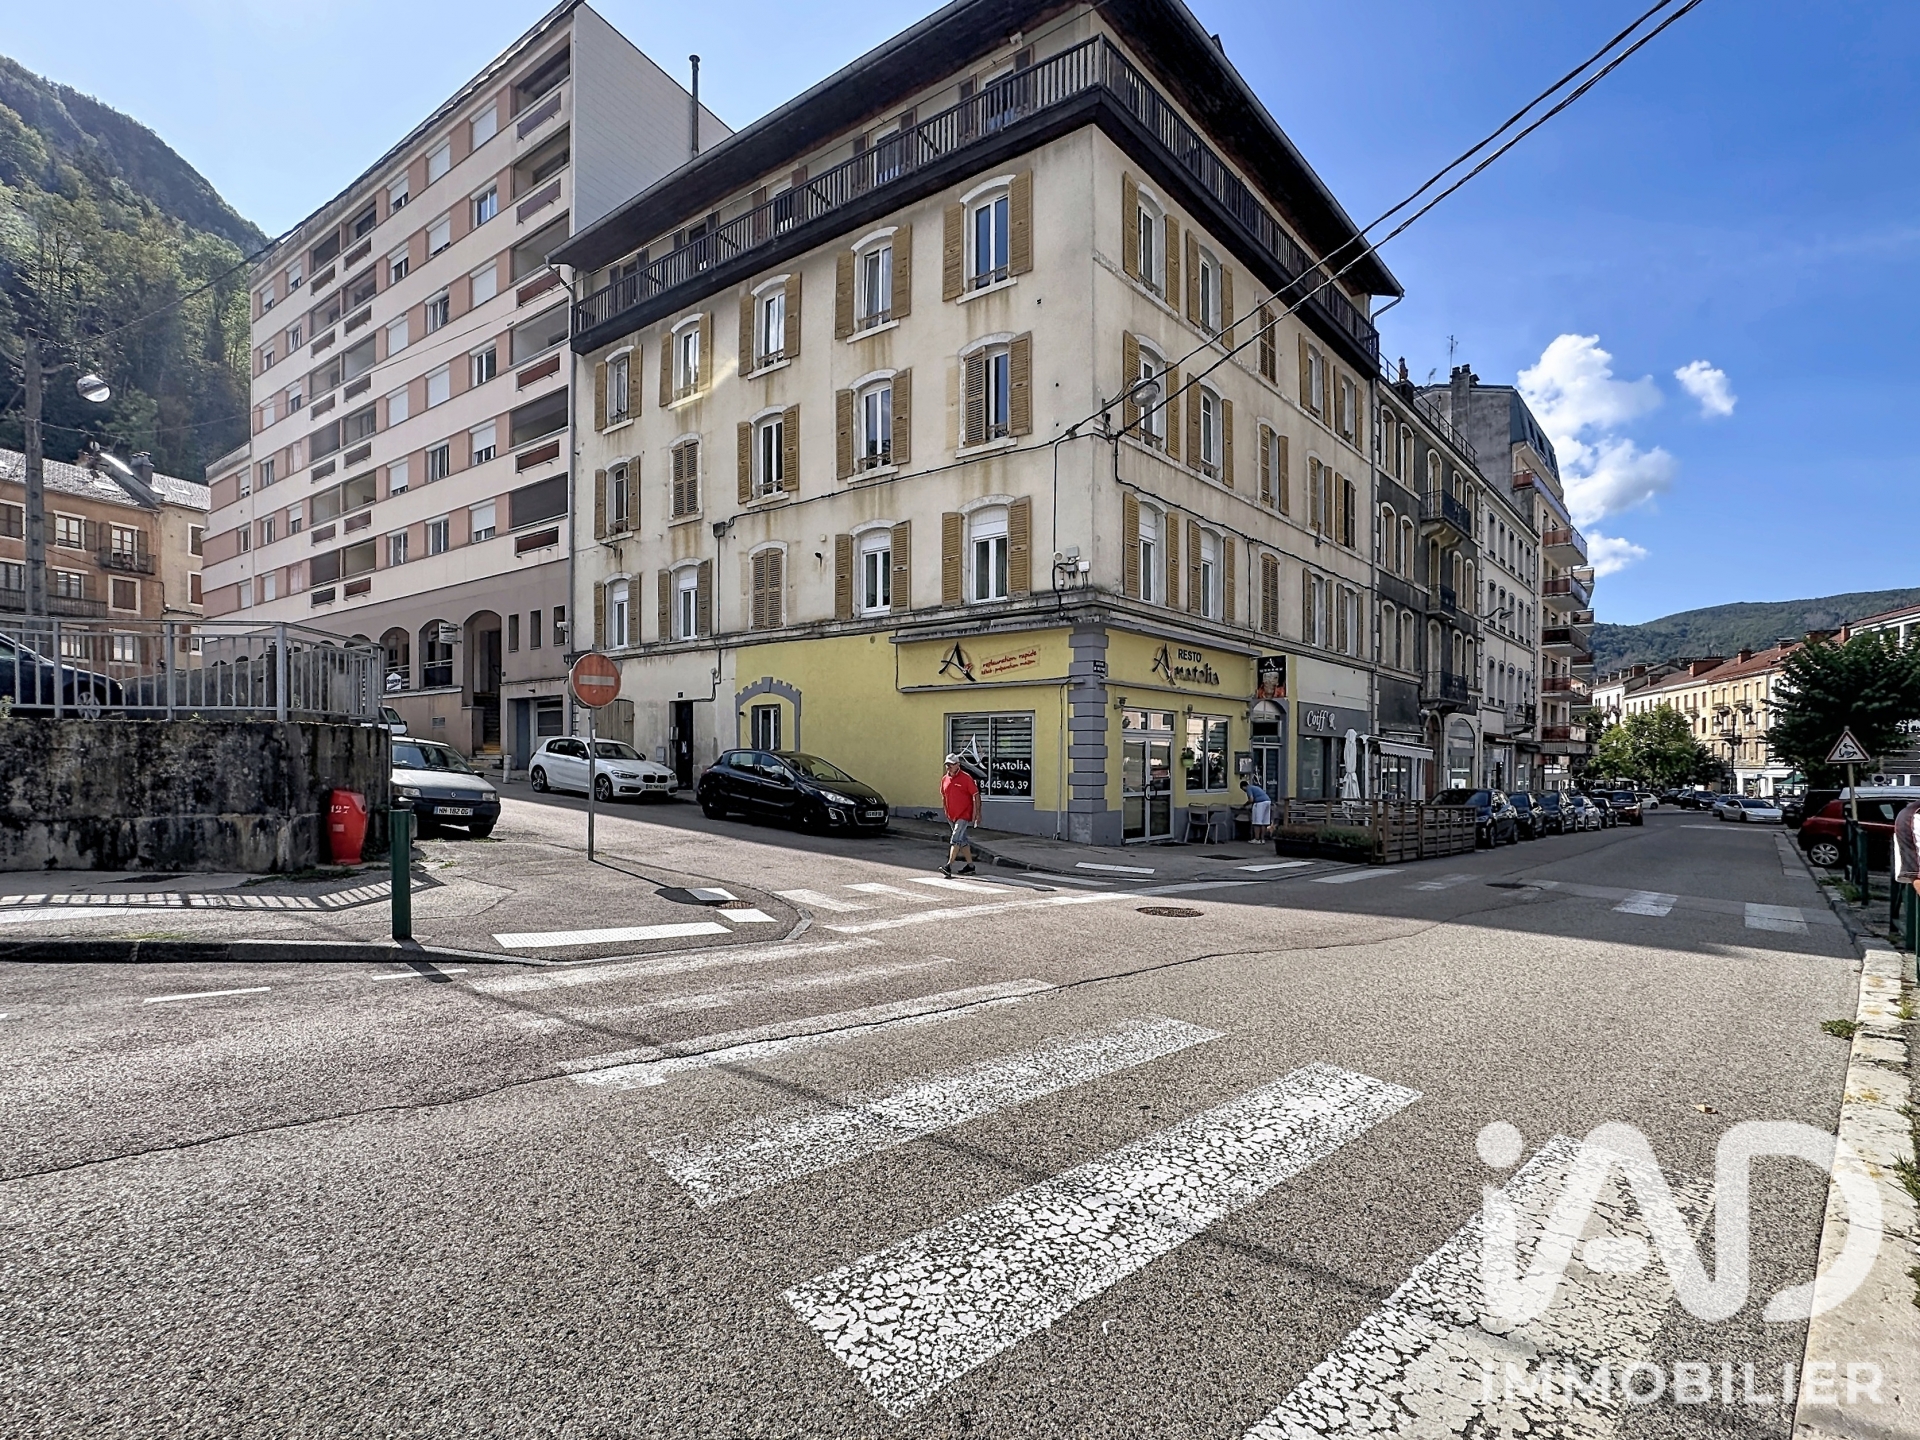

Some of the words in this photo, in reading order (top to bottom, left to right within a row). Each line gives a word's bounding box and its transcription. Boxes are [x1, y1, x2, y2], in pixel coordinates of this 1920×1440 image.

[982, 655, 1017, 668] restauration
[1018, 649, 1037, 660] rapide
[1178, 648, 1202, 663] RESTO
[991, 780, 1002, 789] 45
[1004, 780, 1015, 789] 43
[1017, 780, 1029, 790] 39
[331, 804, 350, 814] 127
